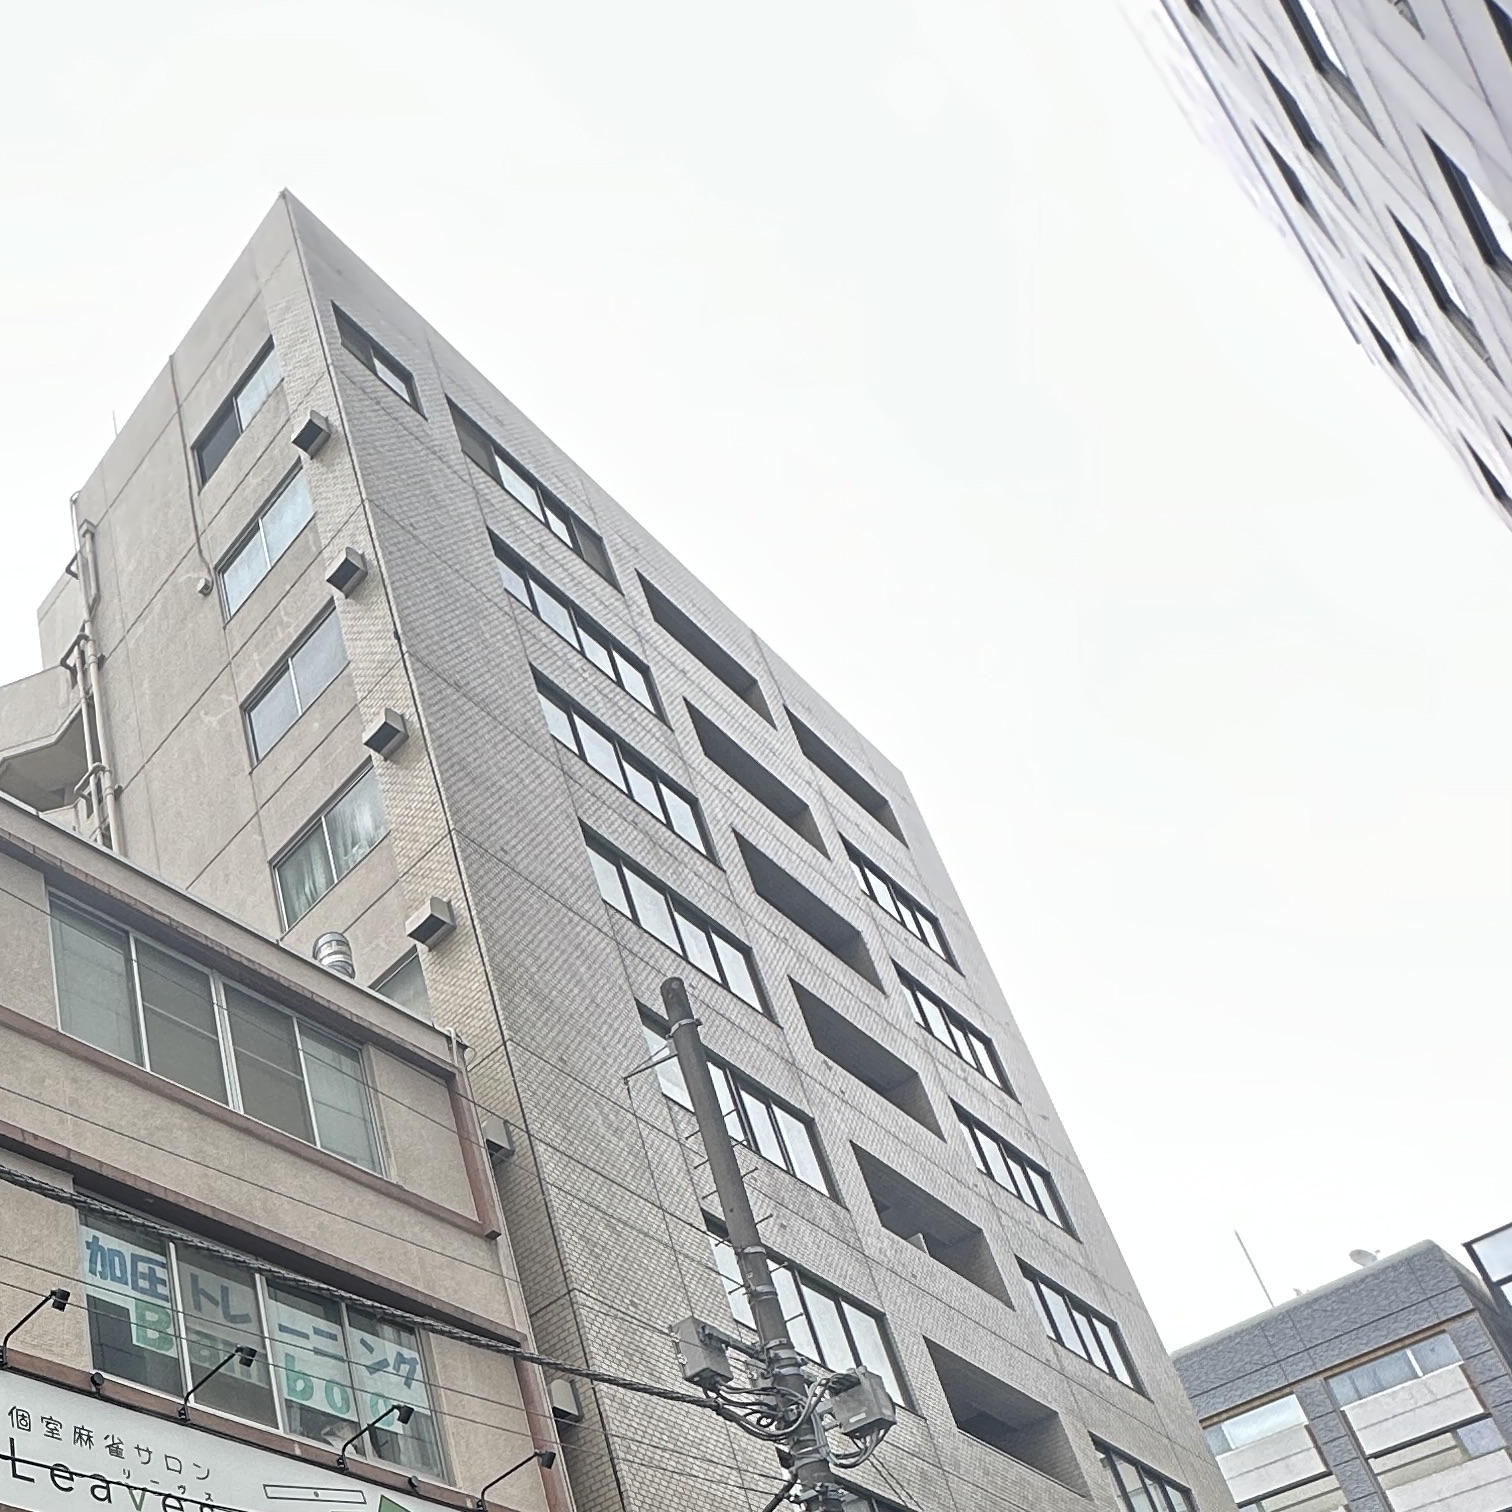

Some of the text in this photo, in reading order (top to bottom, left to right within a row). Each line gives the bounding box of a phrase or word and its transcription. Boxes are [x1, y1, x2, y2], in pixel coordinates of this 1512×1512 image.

[8, 1405, 210, 1481] 個室麻雀サロン
